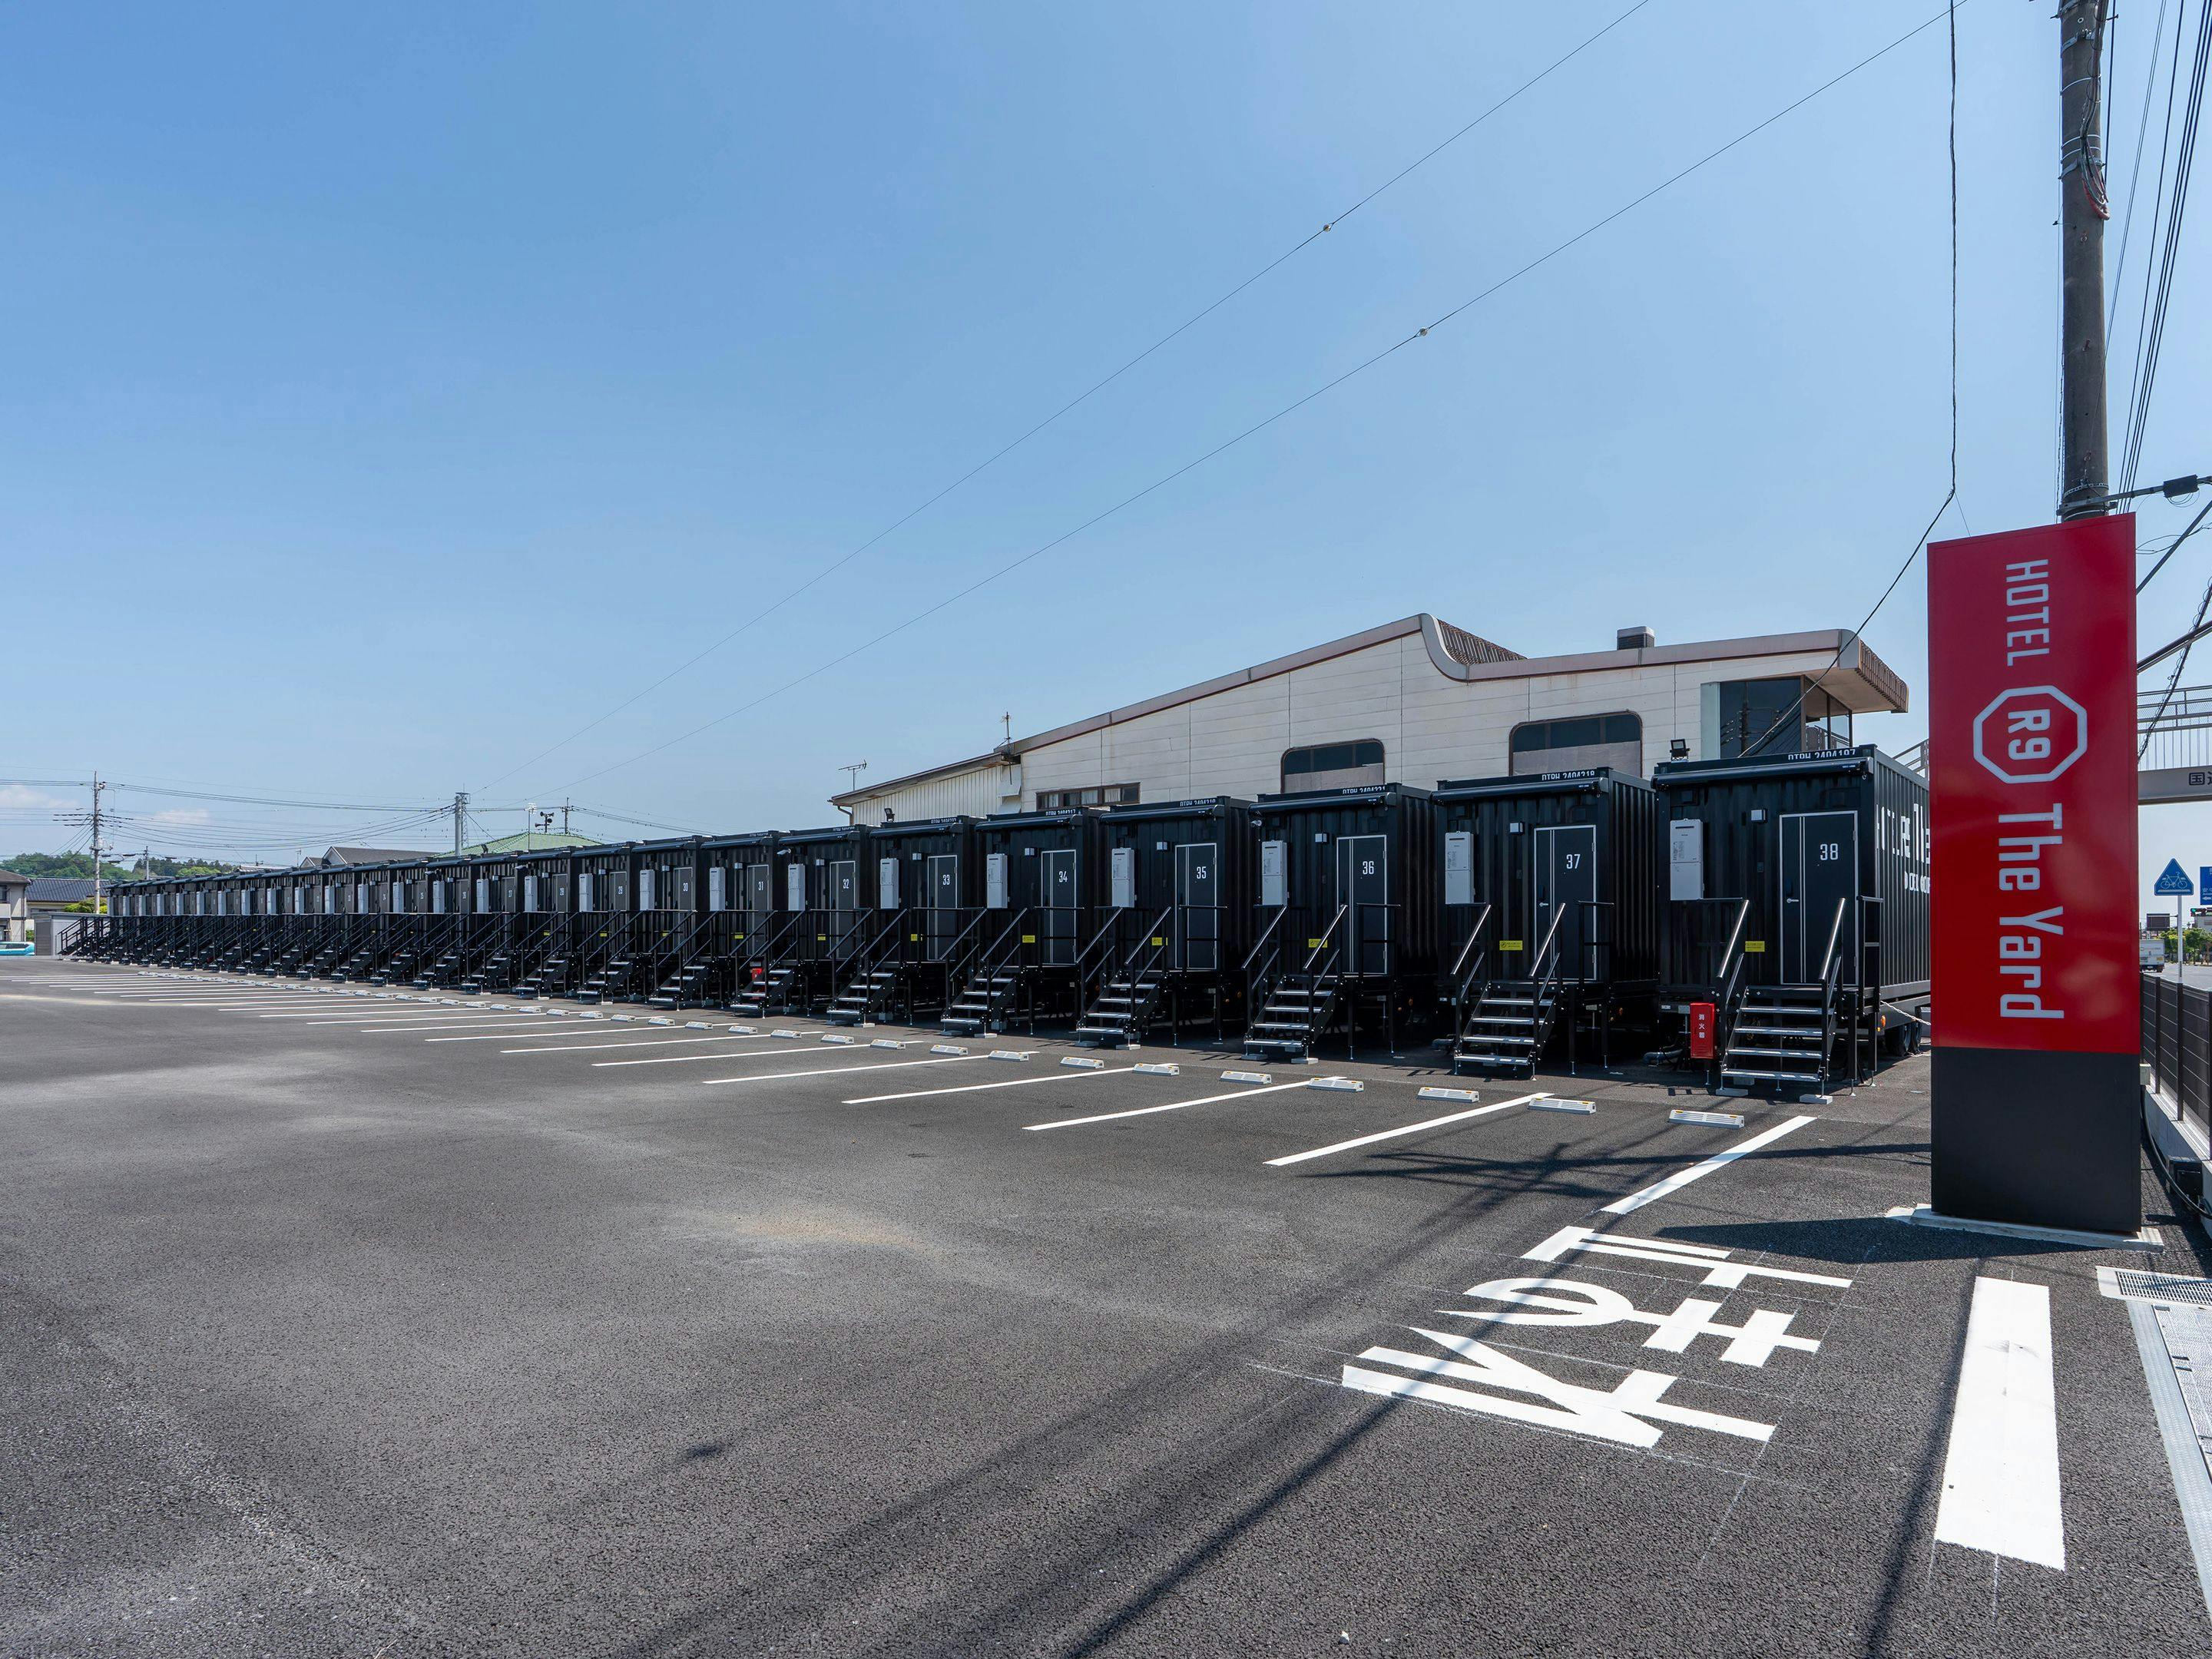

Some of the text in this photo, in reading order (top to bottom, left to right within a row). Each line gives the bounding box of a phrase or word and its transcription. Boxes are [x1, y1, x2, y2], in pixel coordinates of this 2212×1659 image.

[1998, 558, 2065, 1019] HOTEL R9 The Yard
[1820, 843, 1838, 861] 38
[1363, 861, 1373, 875] 36
[1567, 854, 1580, 869] 37
[1059, 870, 1068, 882] 34
[1197, 866, 1206, 879] 35
[683, 882, 689, 892] 30
[758, 881, 763, 891] 31
[843, 879, 849, 889] 32
[942, 875, 950, 886] 33
[1342, 1226, 1852, 1449] 止まれ
